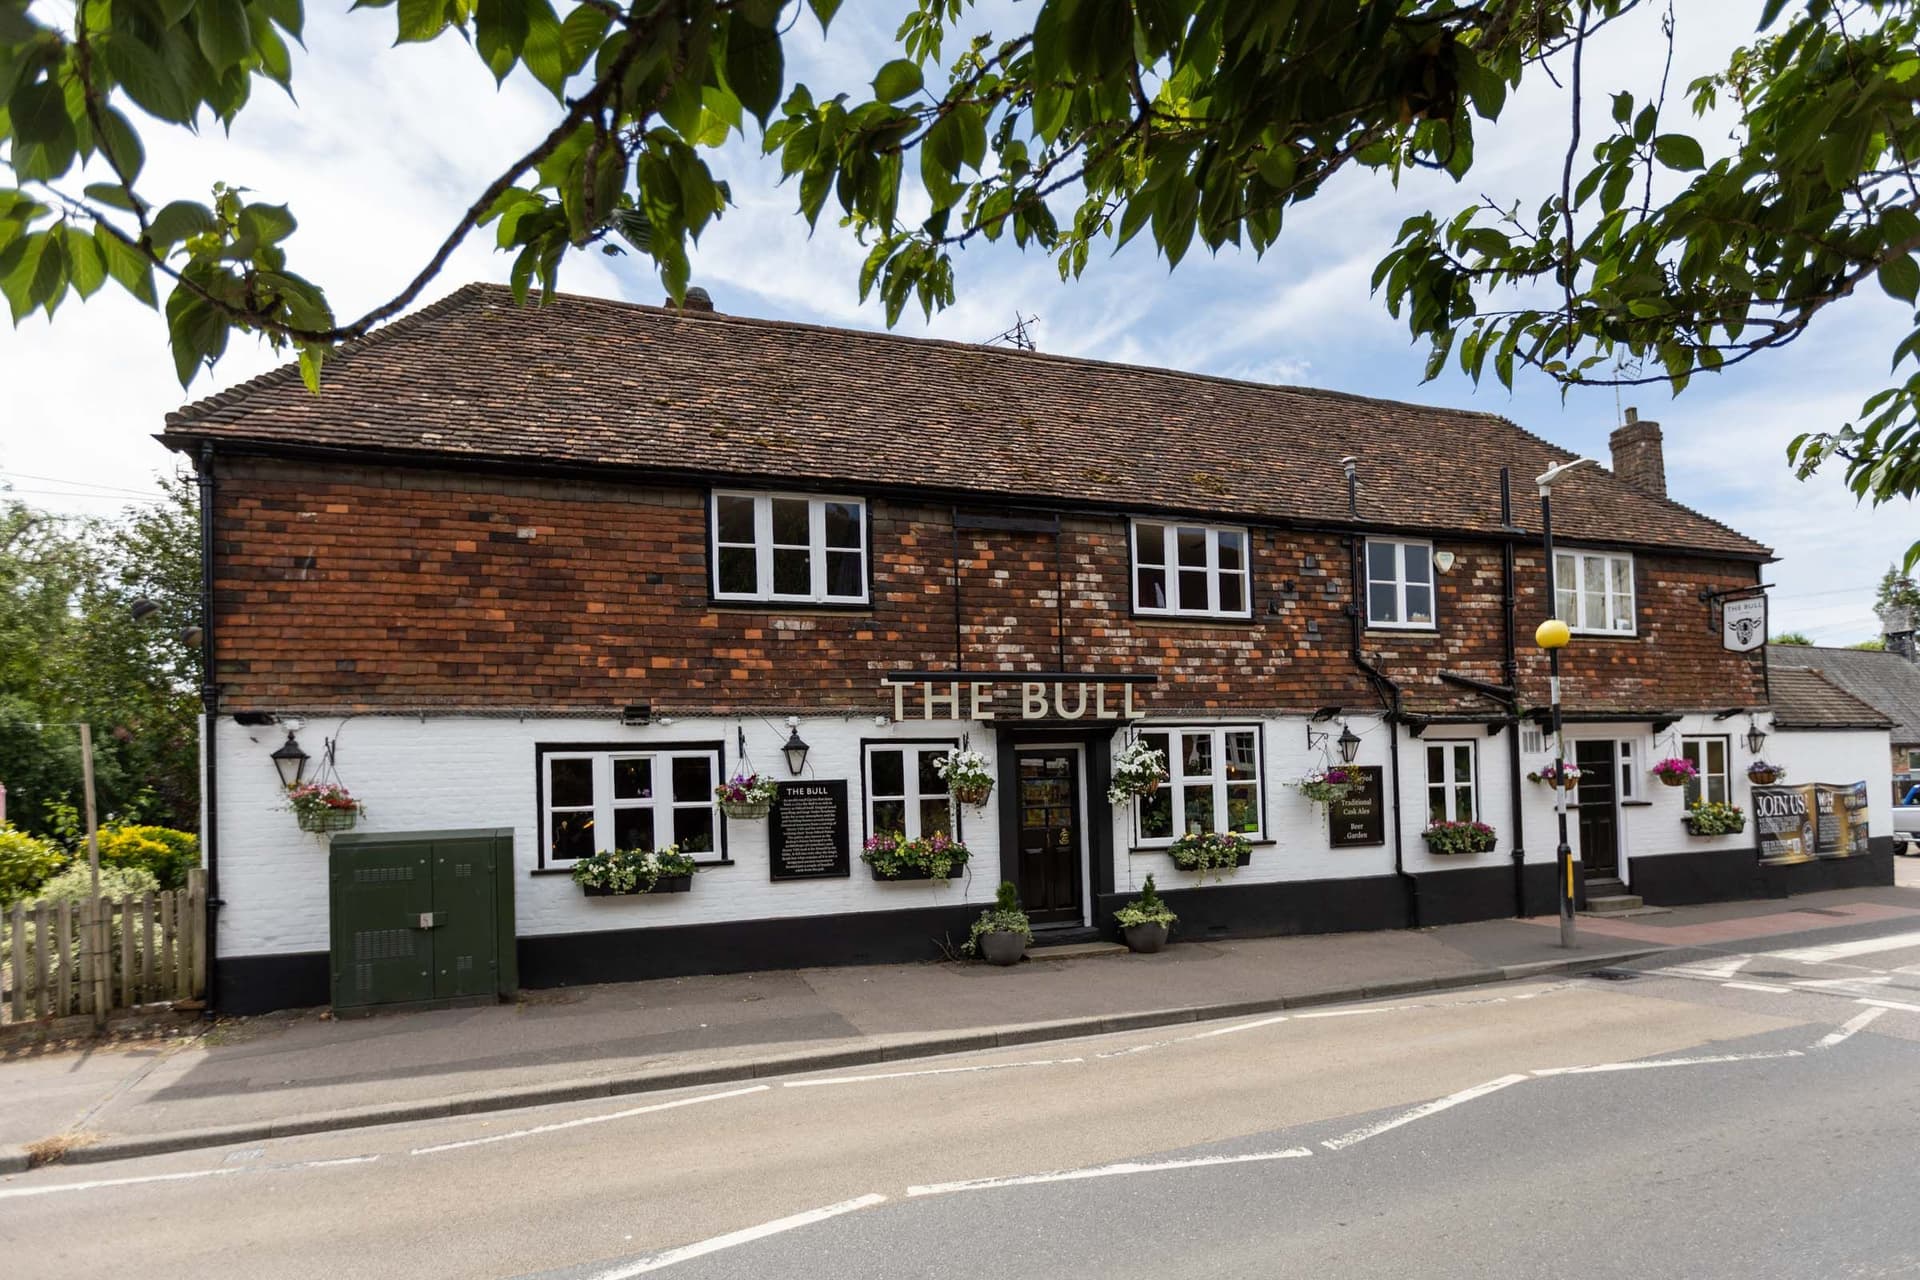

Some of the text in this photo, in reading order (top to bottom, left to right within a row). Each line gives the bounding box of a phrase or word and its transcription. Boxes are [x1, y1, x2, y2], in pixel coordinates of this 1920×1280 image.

[881, 679, 1146, 721] THE BULL
[787, 787, 828, 796] THE BULL
[1358, 807, 1370, 815] Ales
[1756, 793, 1809, 817] JOIN US!
